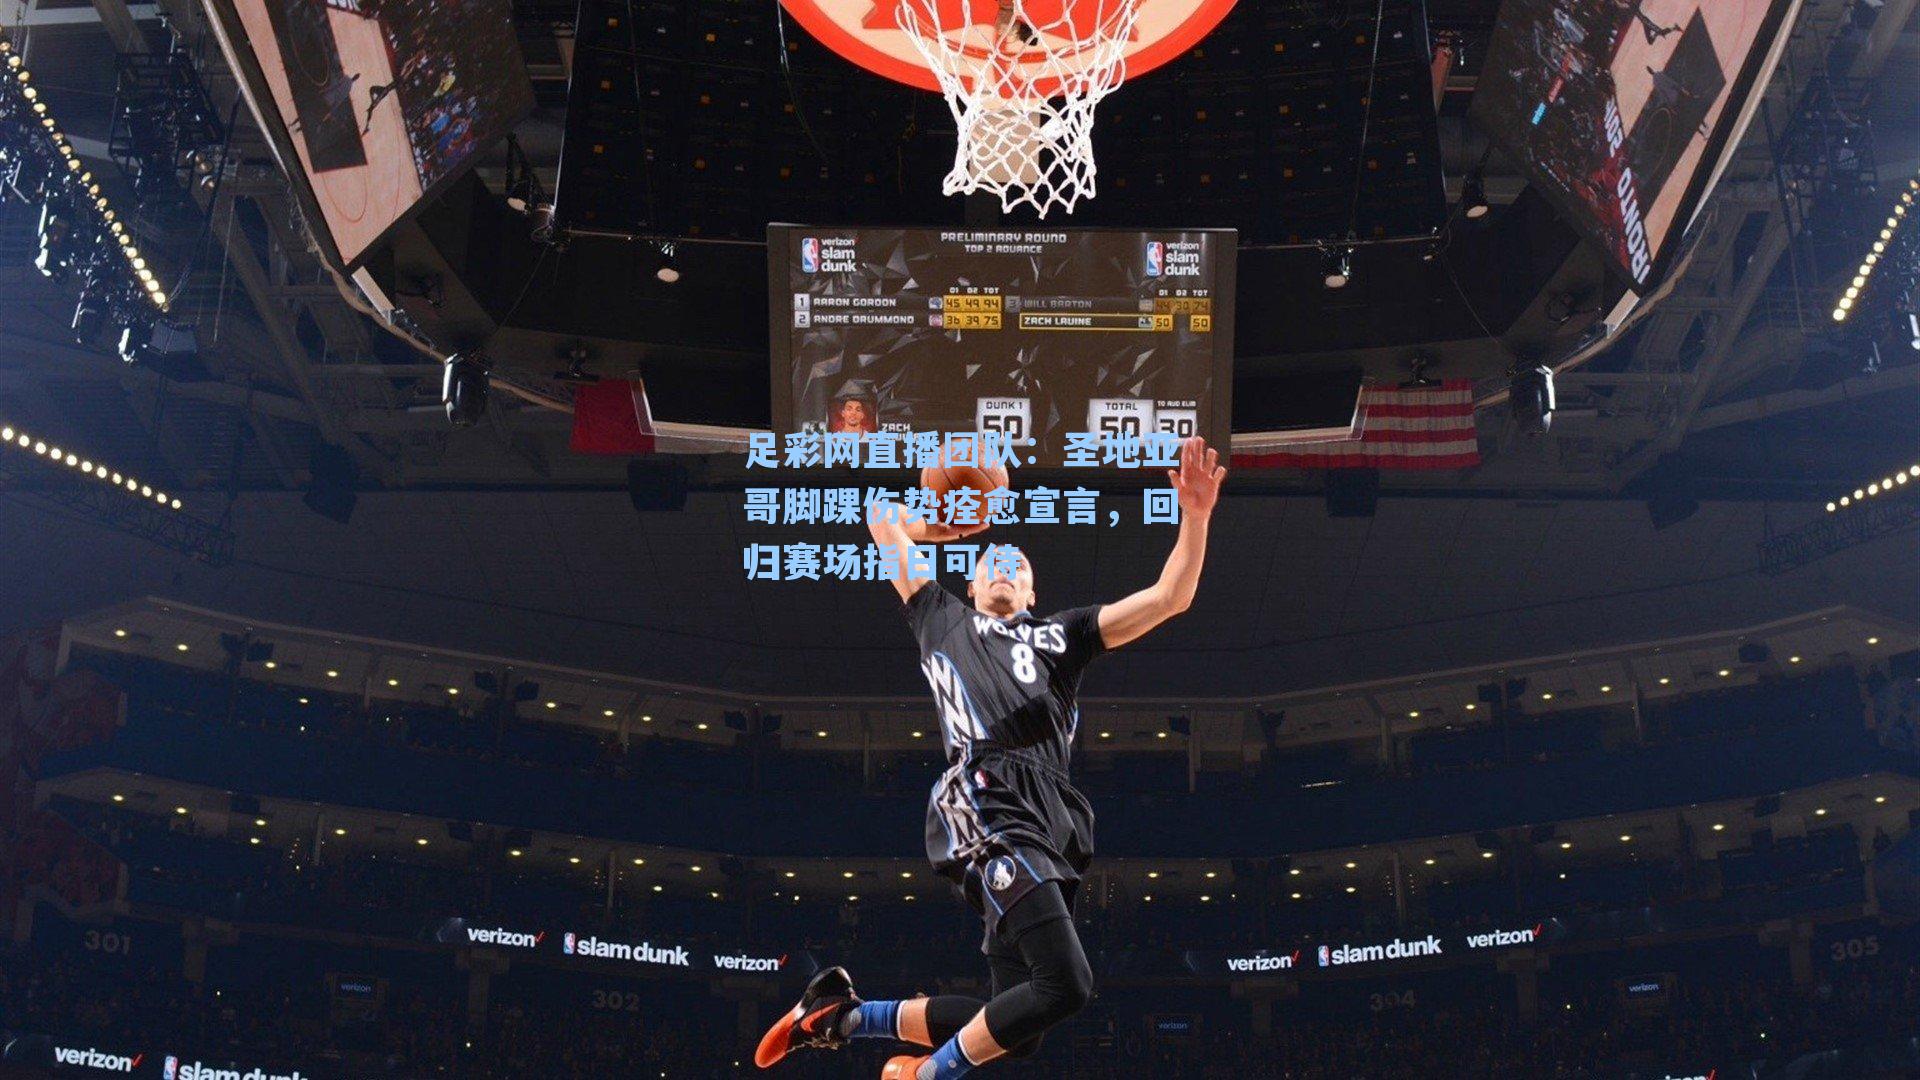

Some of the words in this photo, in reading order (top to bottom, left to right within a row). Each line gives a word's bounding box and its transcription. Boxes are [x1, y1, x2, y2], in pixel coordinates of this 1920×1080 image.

[821, 238, 855, 246] verizon
[941, 232, 1021, 242] PRELIMINARY
[1025, 233, 1067, 243] ROUND
[964, 244, 984, 253] TOP
[986, 245, 993, 253] 2
[995, 245, 1043, 254] ADVANCE
[1166, 242, 1200, 250] verizon
[821, 247, 855, 259] slam
[1165, 252, 1200, 263] slam
[821, 260, 857, 272] dunk
[1165, 264, 1200, 276] dunk
[799, 297, 805, 307] 1
[813, 298, 849, 307] AARON
[853, 298, 897, 307] GORDON
[946, 299, 960, 308] 45
[965, 299, 980, 308] 49
[983, 299, 999, 308] 94
[1024, 300, 1048, 308] WILL
[1050, 300, 1092, 308] BARTON
[798, 315, 806, 324] 2
[813, 315, 849, 324] ANDRE
[853, 316, 915, 325] DRUMMOND
[966, 316, 980, 325] 39
[984, 316, 999, 325] 75
[1024, 317, 1052, 325] ZACH
[1054, 317, 1092, 326] LAVINE
[1156, 318, 1170, 327] 50
[1193, 318, 1208, 327] 50
[986, 402, 1015, 410] DUNK
[881, 423, 911, 433] ZACH
[983, 415, 1023, 440] 50
[1101, 416, 1140, 440] 50
[1160, 419, 1193, 438] 30
[973, 616, 1067, 654] WOLVES
[1011, 643, 1037, 684] 8
[84, 930, 132, 955] 301
[467, 927, 536, 948] verizon
[1467, 928, 1534, 949] verizon
[577, 936, 631, 960] slam
[633, 941, 690, 967] dunk
[1331, 944, 1384, 966] slam
[1385, 935, 1442, 960] dunk
[1829, 935, 1880, 962] 305
[714, 954, 780, 972] verizon
[1227, 952, 1293, 972] verizon
[1628, 981, 1660, 993] verizon
[55, 1046, 133, 1073] verizon
